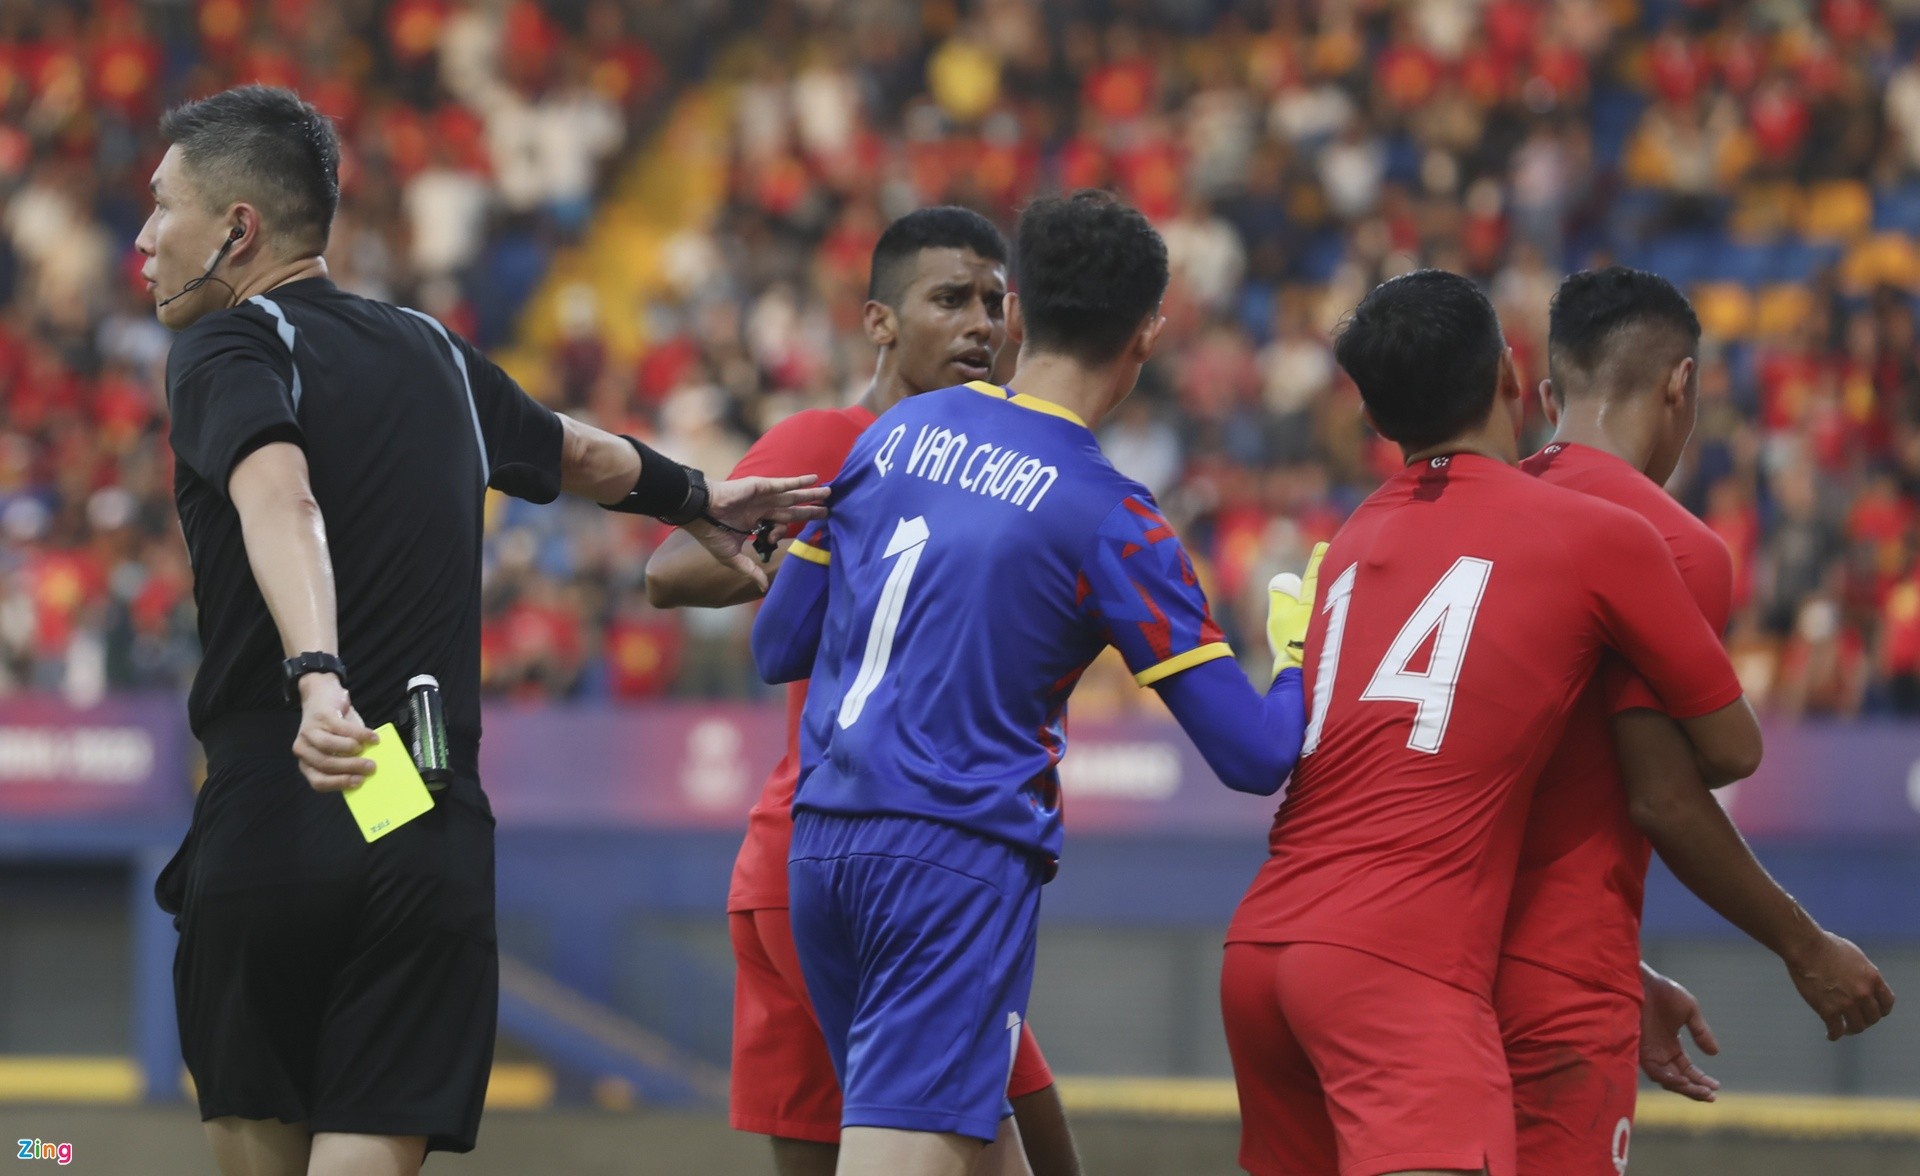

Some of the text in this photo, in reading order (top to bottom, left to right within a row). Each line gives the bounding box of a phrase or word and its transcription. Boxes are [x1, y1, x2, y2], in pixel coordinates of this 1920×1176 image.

[874, 423, 1059, 513] Q. VAN CHUAN
[837, 515, 930, 730] 1
[1301, 556, 1494, 757] 14
